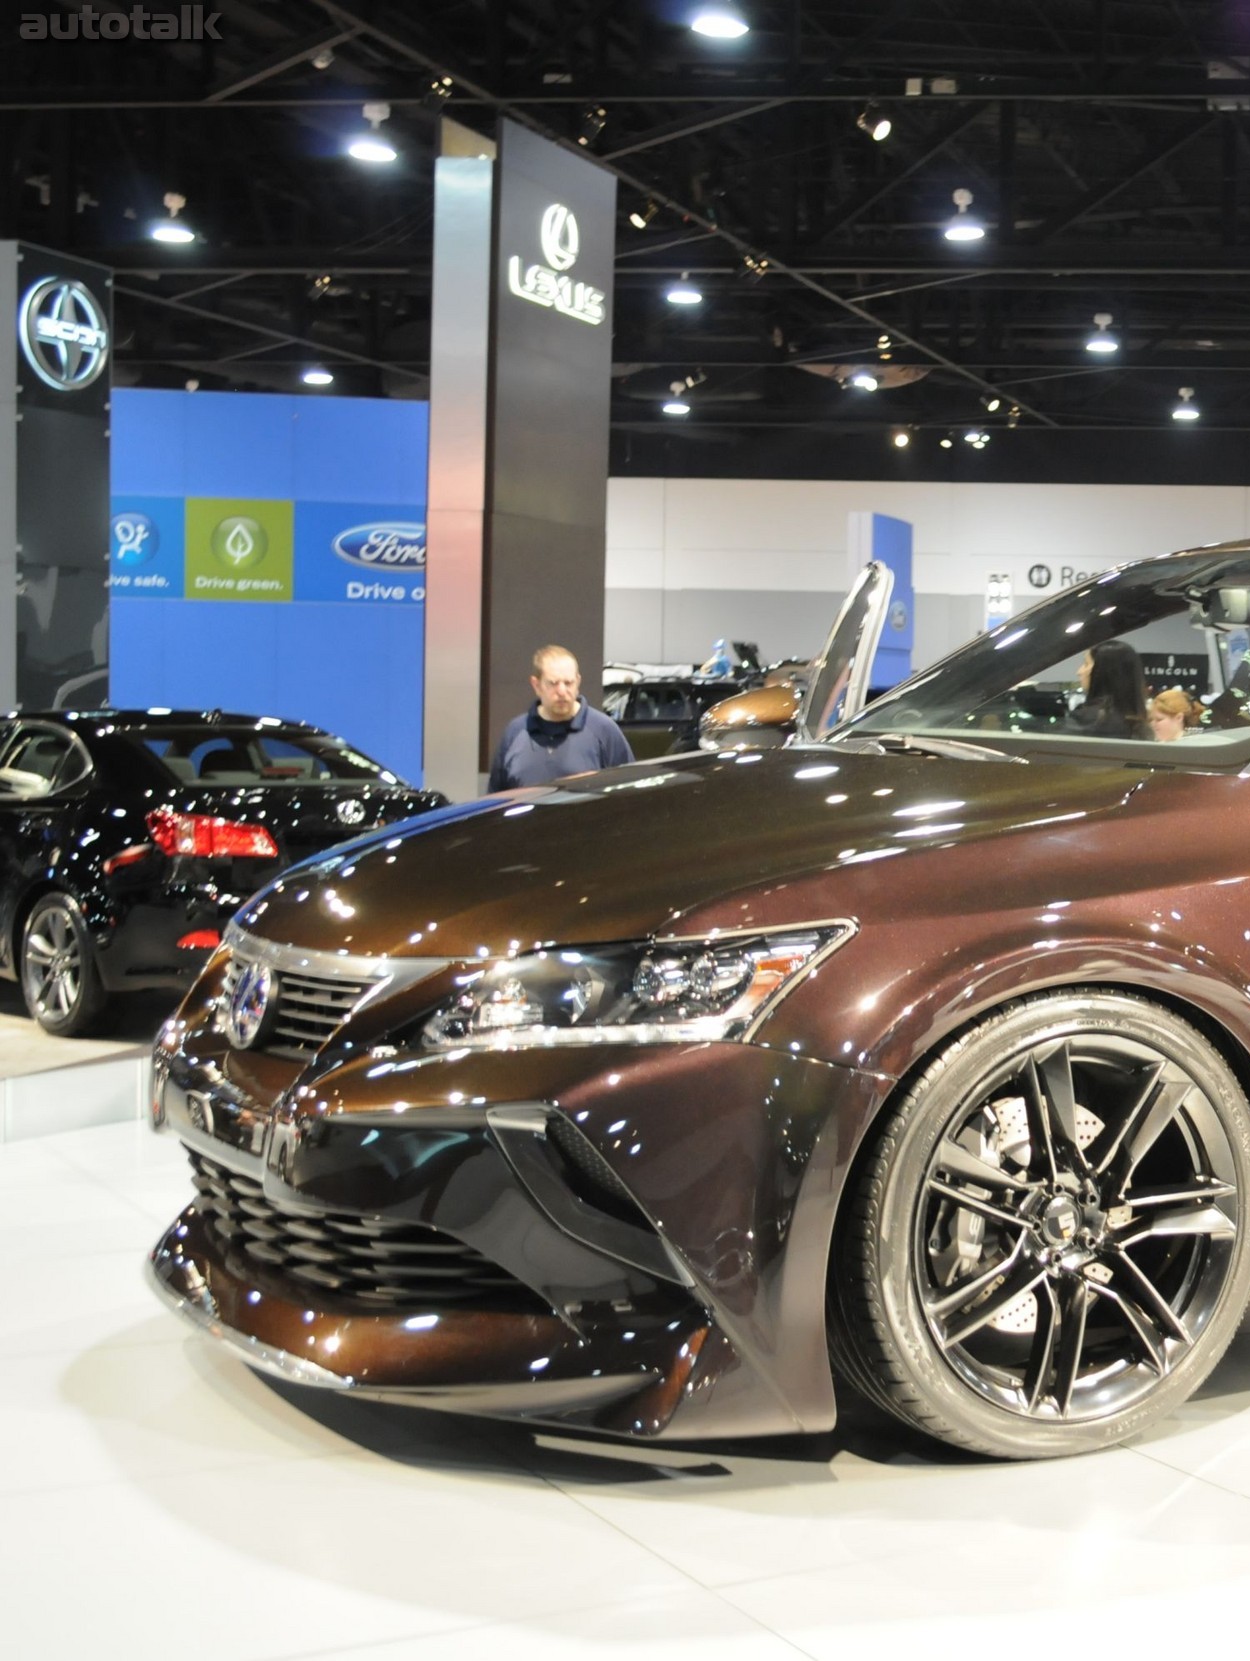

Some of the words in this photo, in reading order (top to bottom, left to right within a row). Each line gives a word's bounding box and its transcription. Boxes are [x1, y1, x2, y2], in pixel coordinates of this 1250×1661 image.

[508, 255, 606, 326] LEXUS
[195, 575, 235, 590] Drive
[346, 580, 406, 601] Drive
[1143, 666, 1198, 676] LINCOLN
